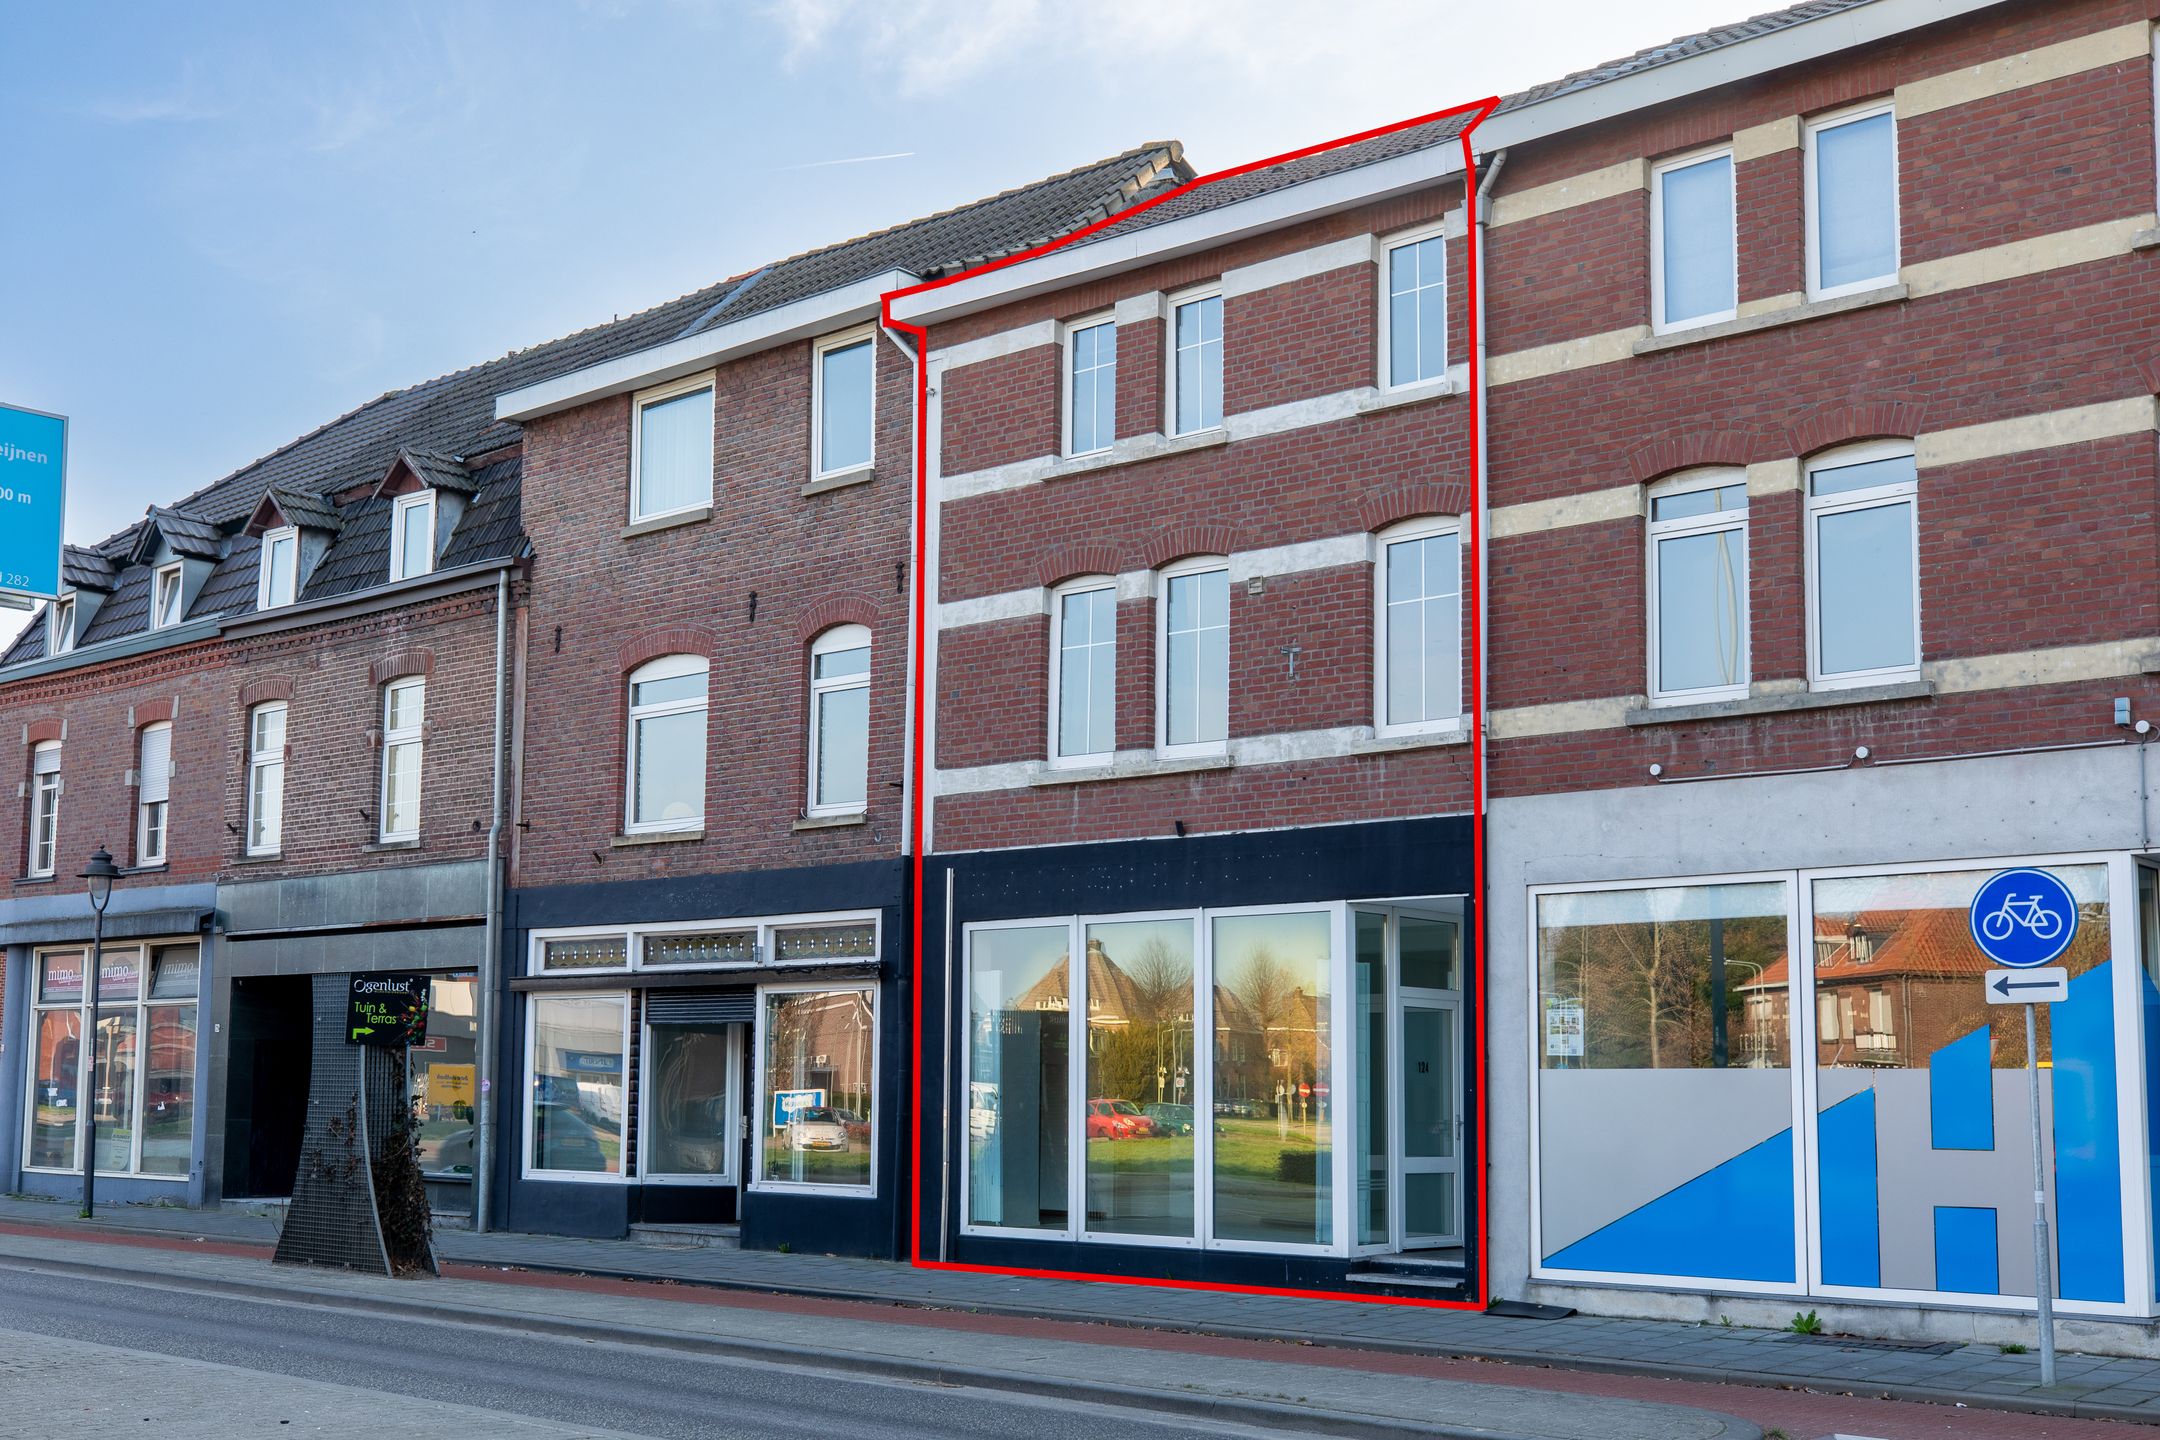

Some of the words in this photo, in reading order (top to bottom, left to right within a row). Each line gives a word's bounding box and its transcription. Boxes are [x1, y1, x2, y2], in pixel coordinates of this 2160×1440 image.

[18, 493, 31, 504] m
[6, 573, 29, 587] 282
[48, 965, 74, 981] mimo
[101, 963, 128, 979] mimo
[163, 959, 194, 975] mimo
[354, 979, 410, 993] Ogenlust
[355, 1001, 376, 1013] Tuin
[379, 1003, 387, 1014] &
[366, 1013, 397, 1024] Terras
